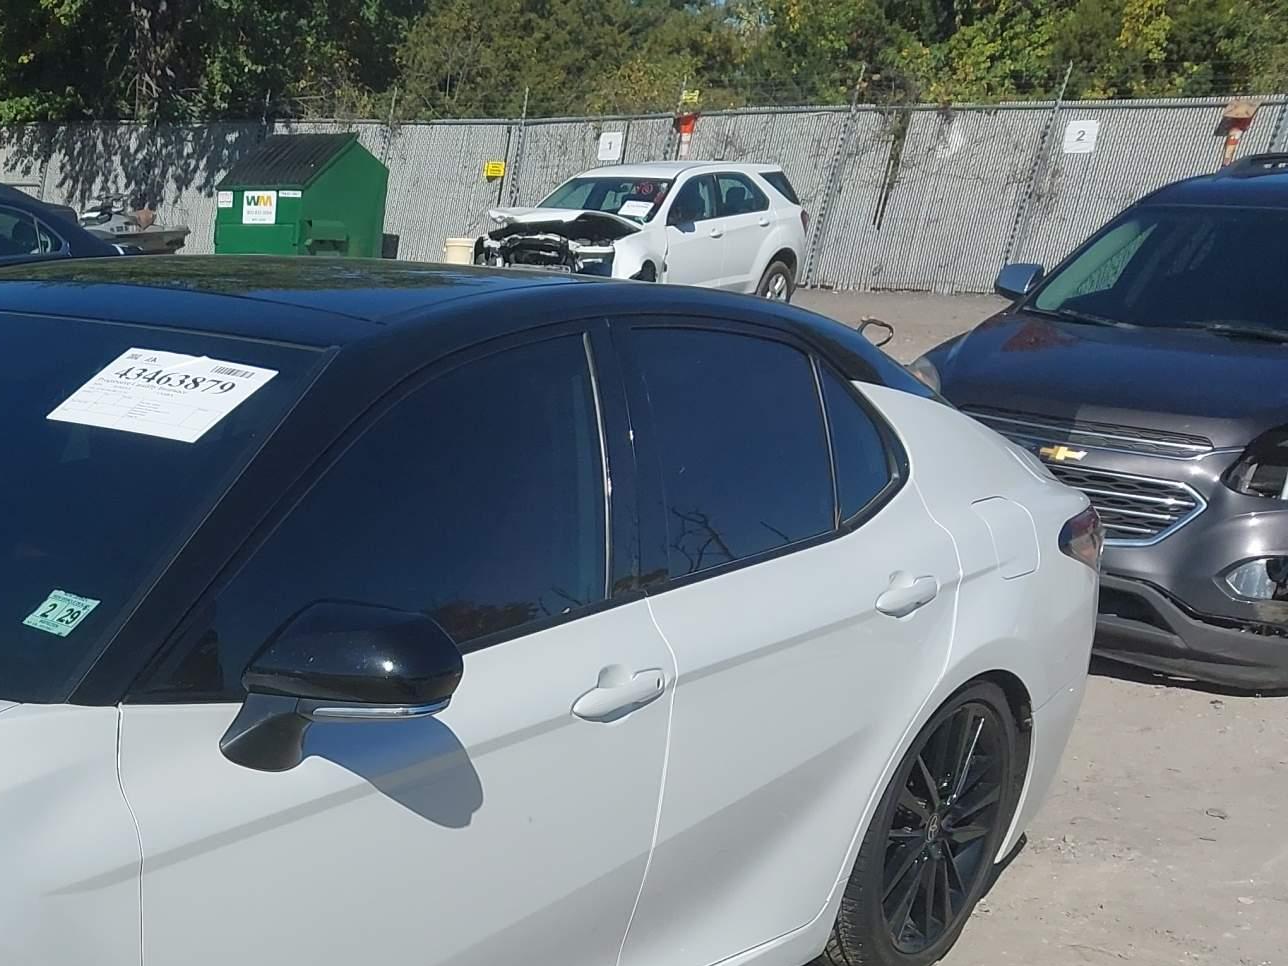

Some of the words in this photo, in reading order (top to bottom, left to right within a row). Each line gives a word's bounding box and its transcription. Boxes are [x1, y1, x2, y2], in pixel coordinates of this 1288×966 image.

[1076, 130, 1086, 141] 2
[246, 195, 273, 206] WM
[114, 366, 236, 394] 43463879
[40, 603, 58, 618] 2
[56, 608, 81, 625] 29
